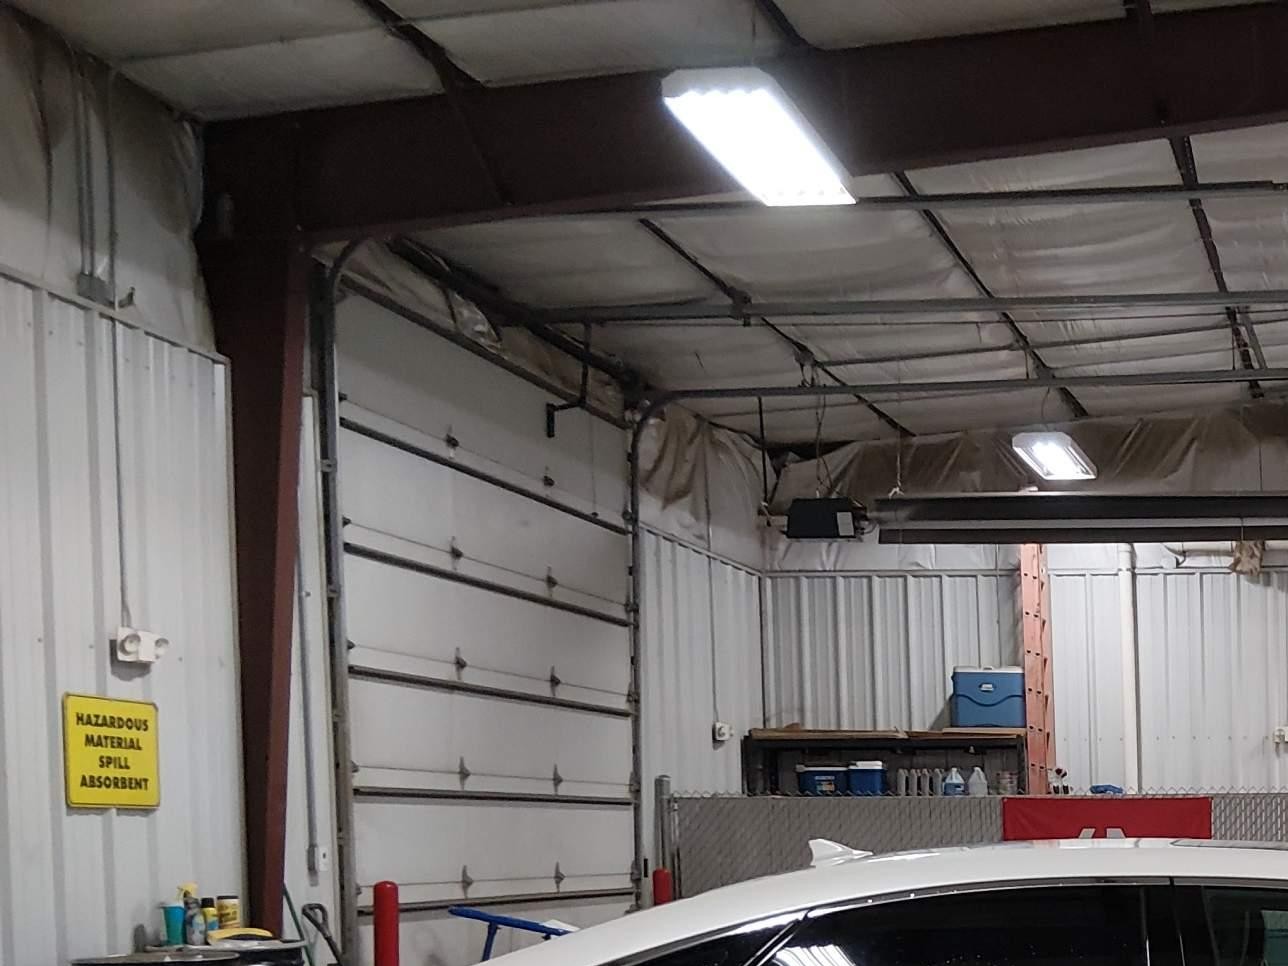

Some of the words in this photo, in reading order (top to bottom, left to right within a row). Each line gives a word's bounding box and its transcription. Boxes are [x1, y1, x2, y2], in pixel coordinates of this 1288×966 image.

[75, 712, 149, 732] HAZARDOUS
[85, 734, 143, 751] MATERIAL
[98, 755, 131, 770] SPILL
[80, 774, 149, 791] ABSORBENT
